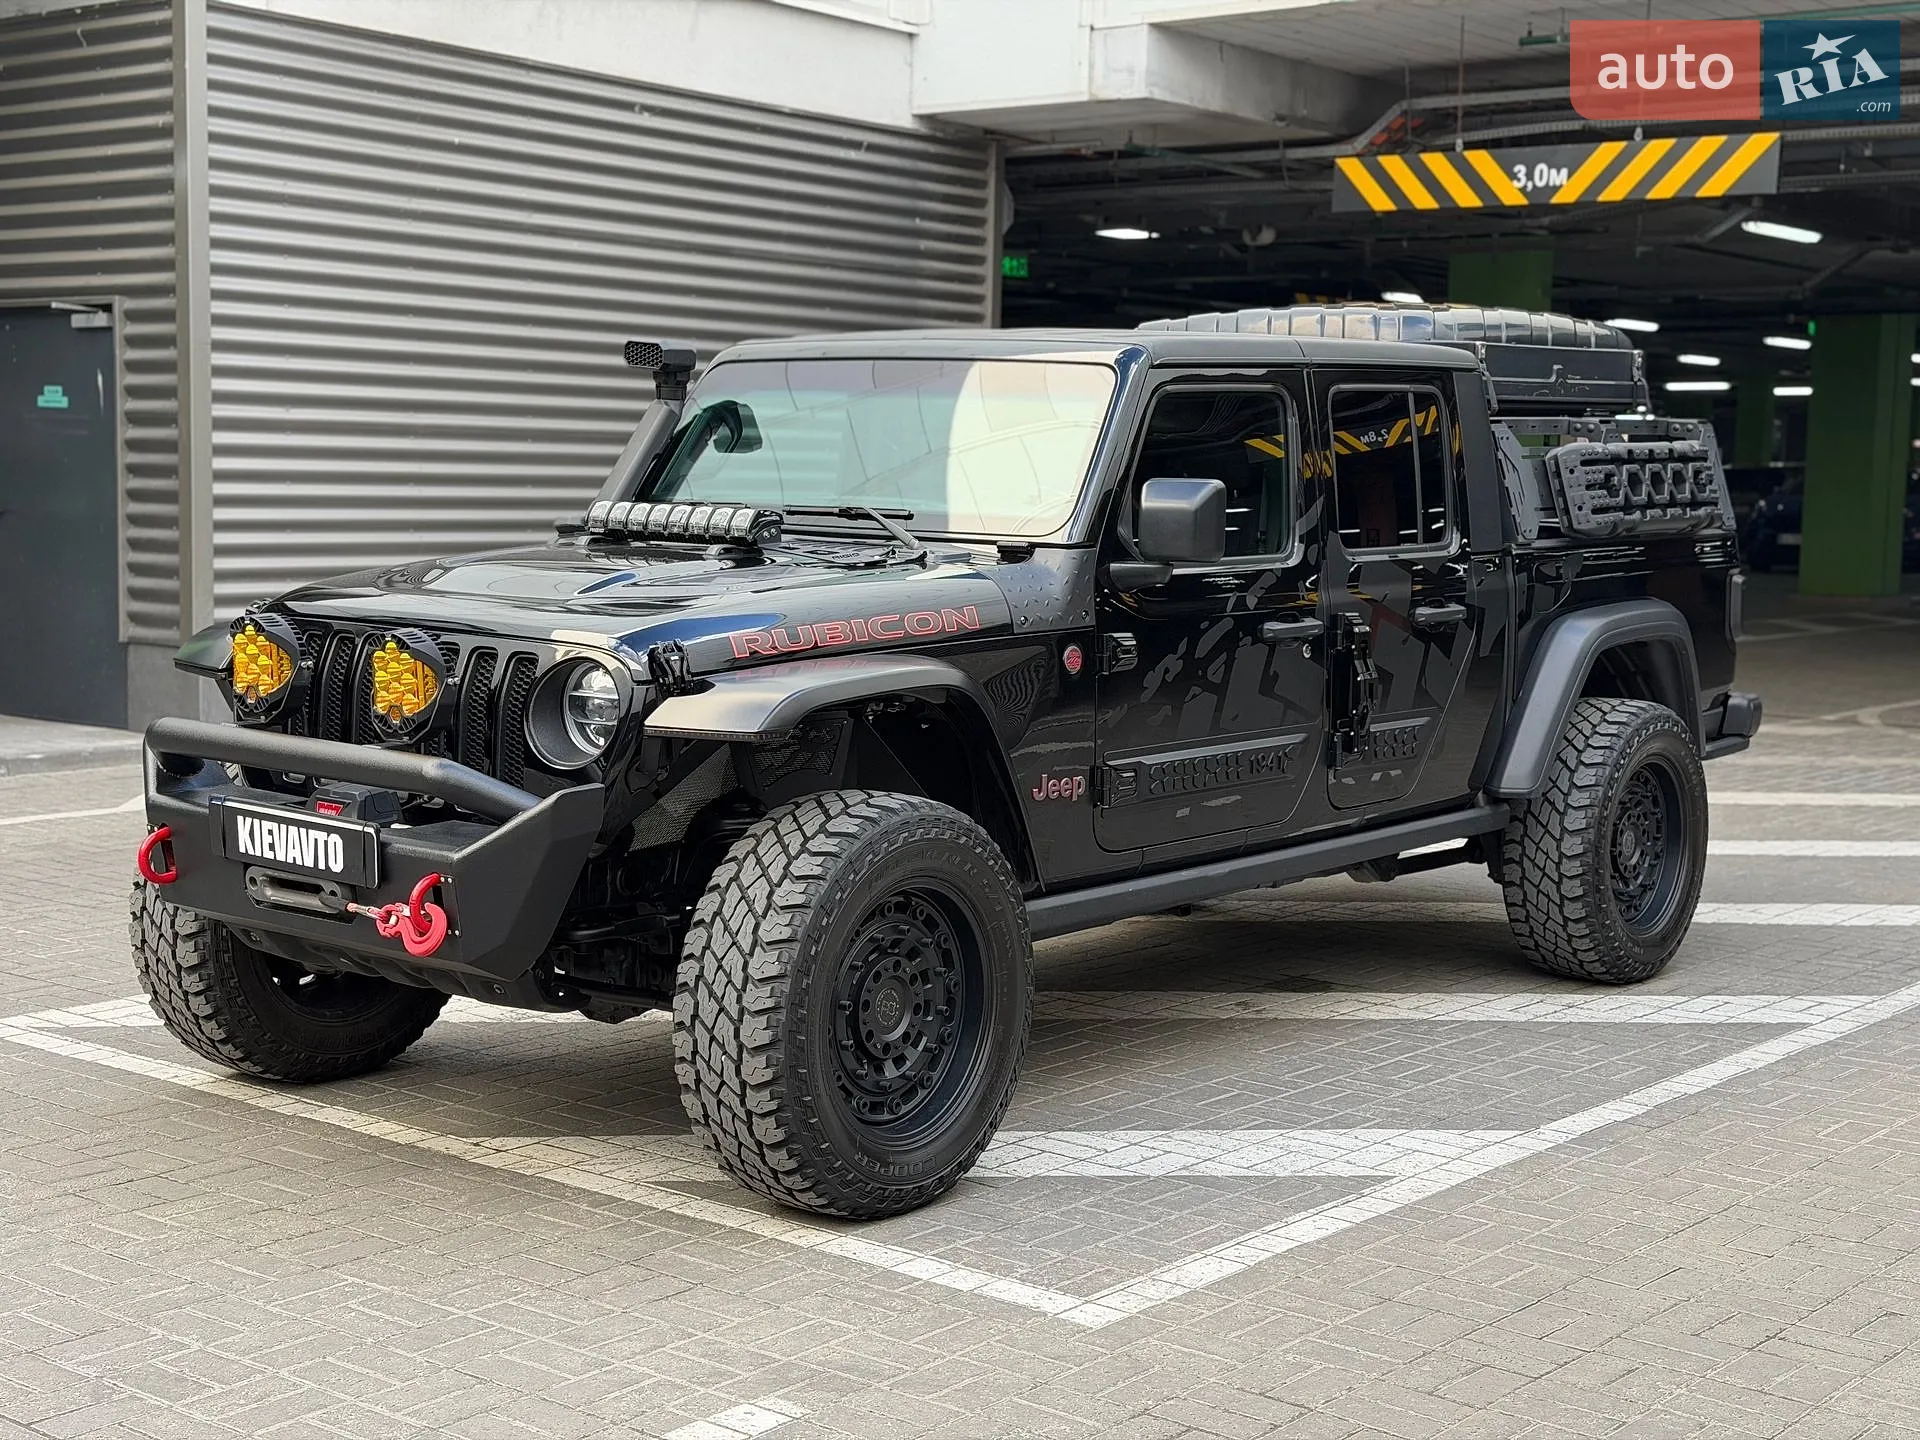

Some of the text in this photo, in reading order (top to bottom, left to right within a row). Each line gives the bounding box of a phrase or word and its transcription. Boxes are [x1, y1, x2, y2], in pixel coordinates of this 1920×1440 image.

[729, 606, 980, 659] RUBICON
[1032, 773, 1086, 801] Jeep
[236, 815, 344, 873] KIEVAVTO
